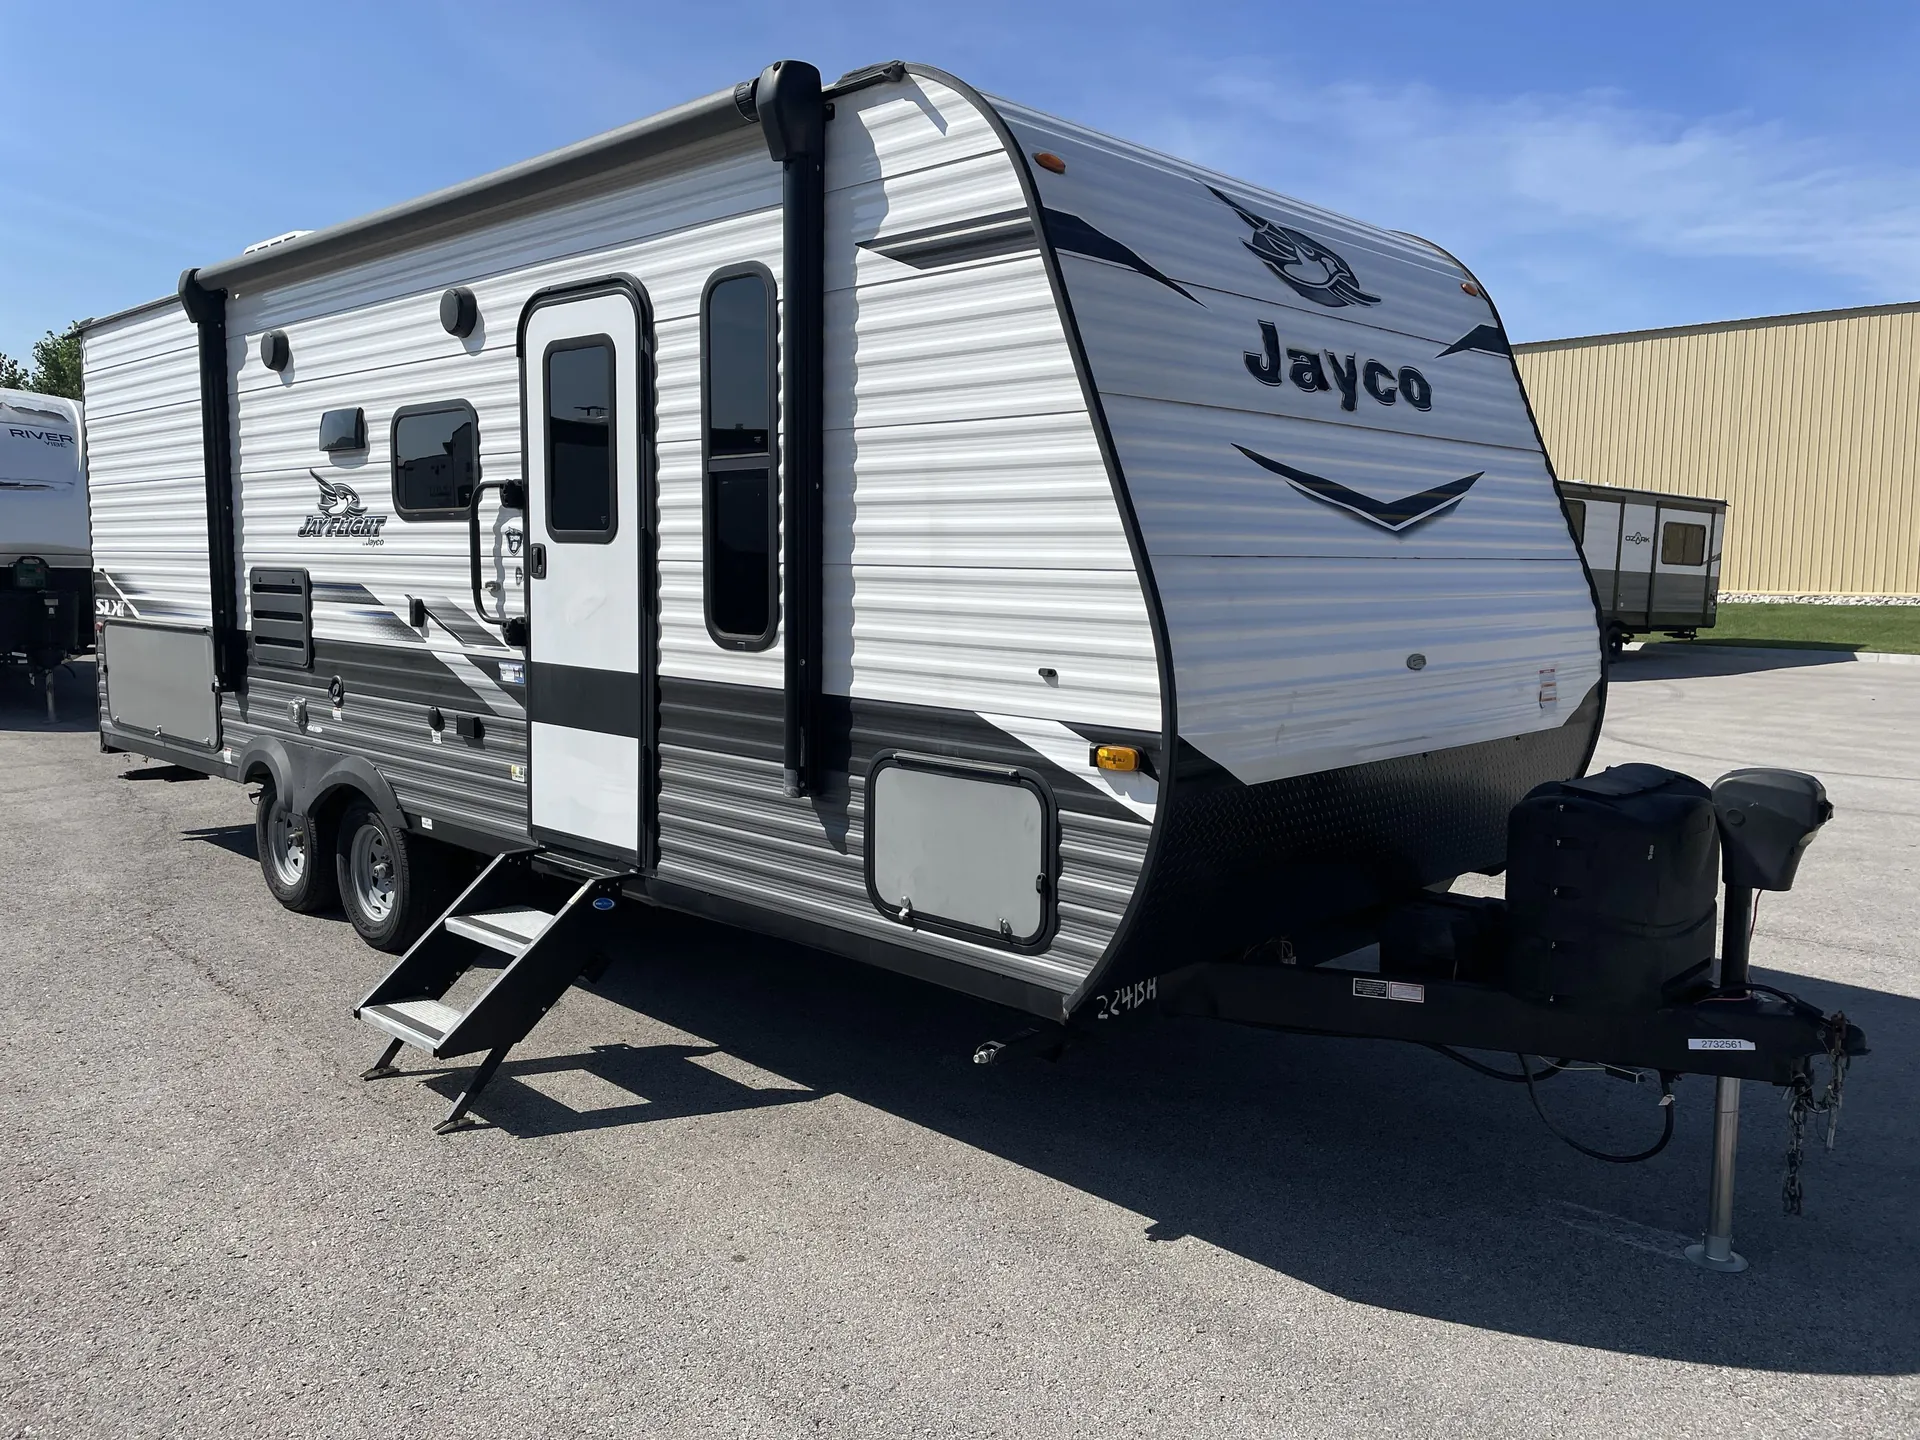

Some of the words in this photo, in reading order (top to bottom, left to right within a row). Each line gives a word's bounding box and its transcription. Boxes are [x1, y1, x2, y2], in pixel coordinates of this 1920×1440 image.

[1243, 319, 1433, 412] Jayco
[9, 428, 75, 444] RIVER
[298, 516, 329, 537] JAY
[325, 516, 387, 537] FLIGHT
[366, 538, 385, 547] Jayco
[1625, 532, 1650, 545] OZARK
[1701, 1040, 1743, 1049] 2732561
